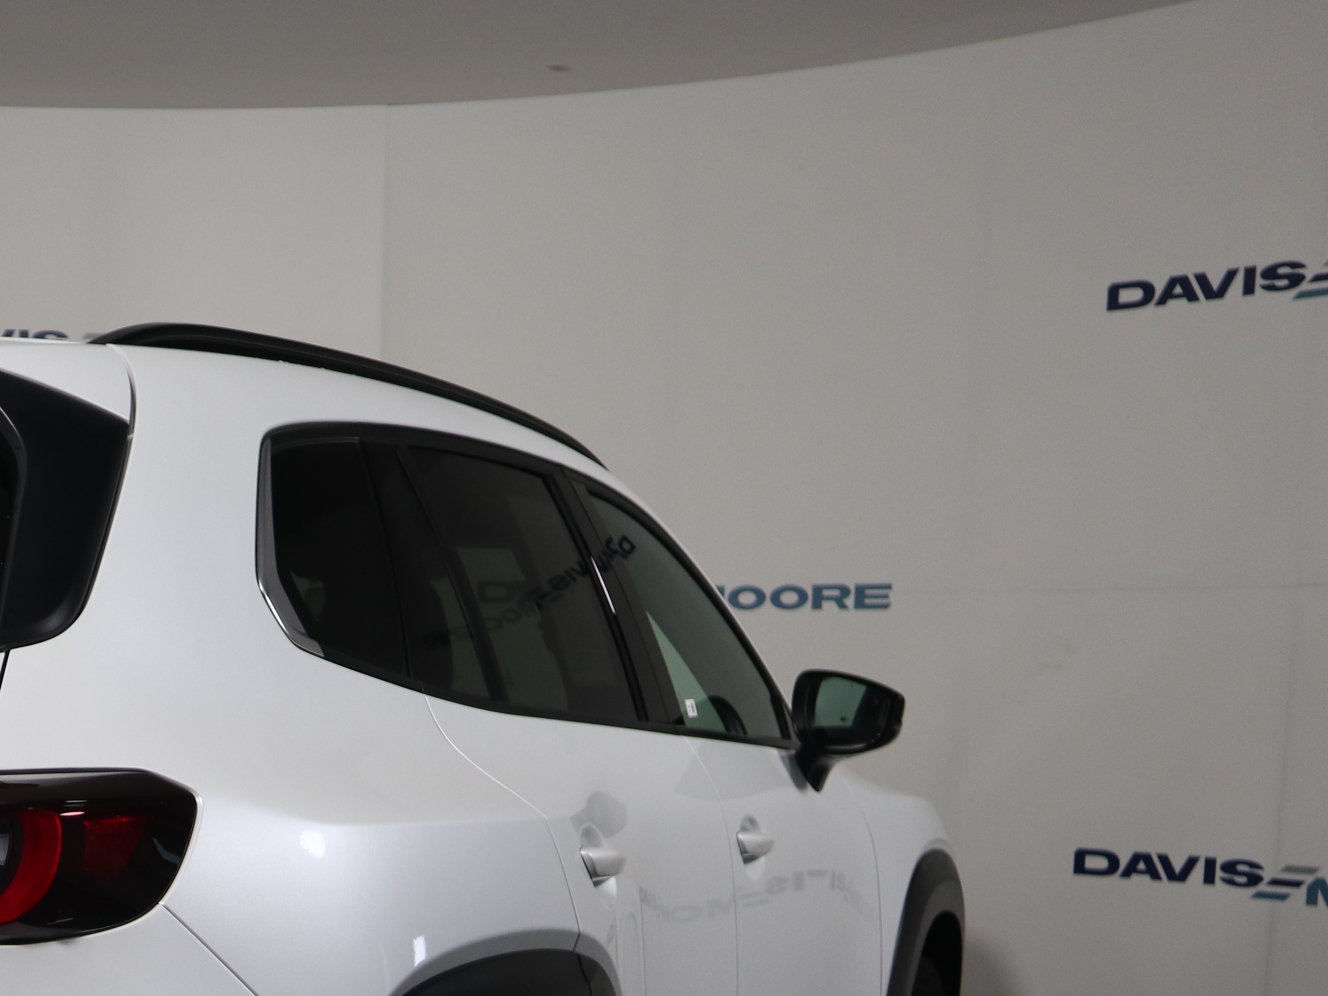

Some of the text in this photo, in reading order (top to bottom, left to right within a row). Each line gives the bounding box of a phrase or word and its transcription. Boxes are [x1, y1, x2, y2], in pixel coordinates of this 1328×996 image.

[1106, 261, 1307, 312] DAVIS
[716, 583, 893, 610] OORE
[1073, 848, 1265, 888] DAVIS
